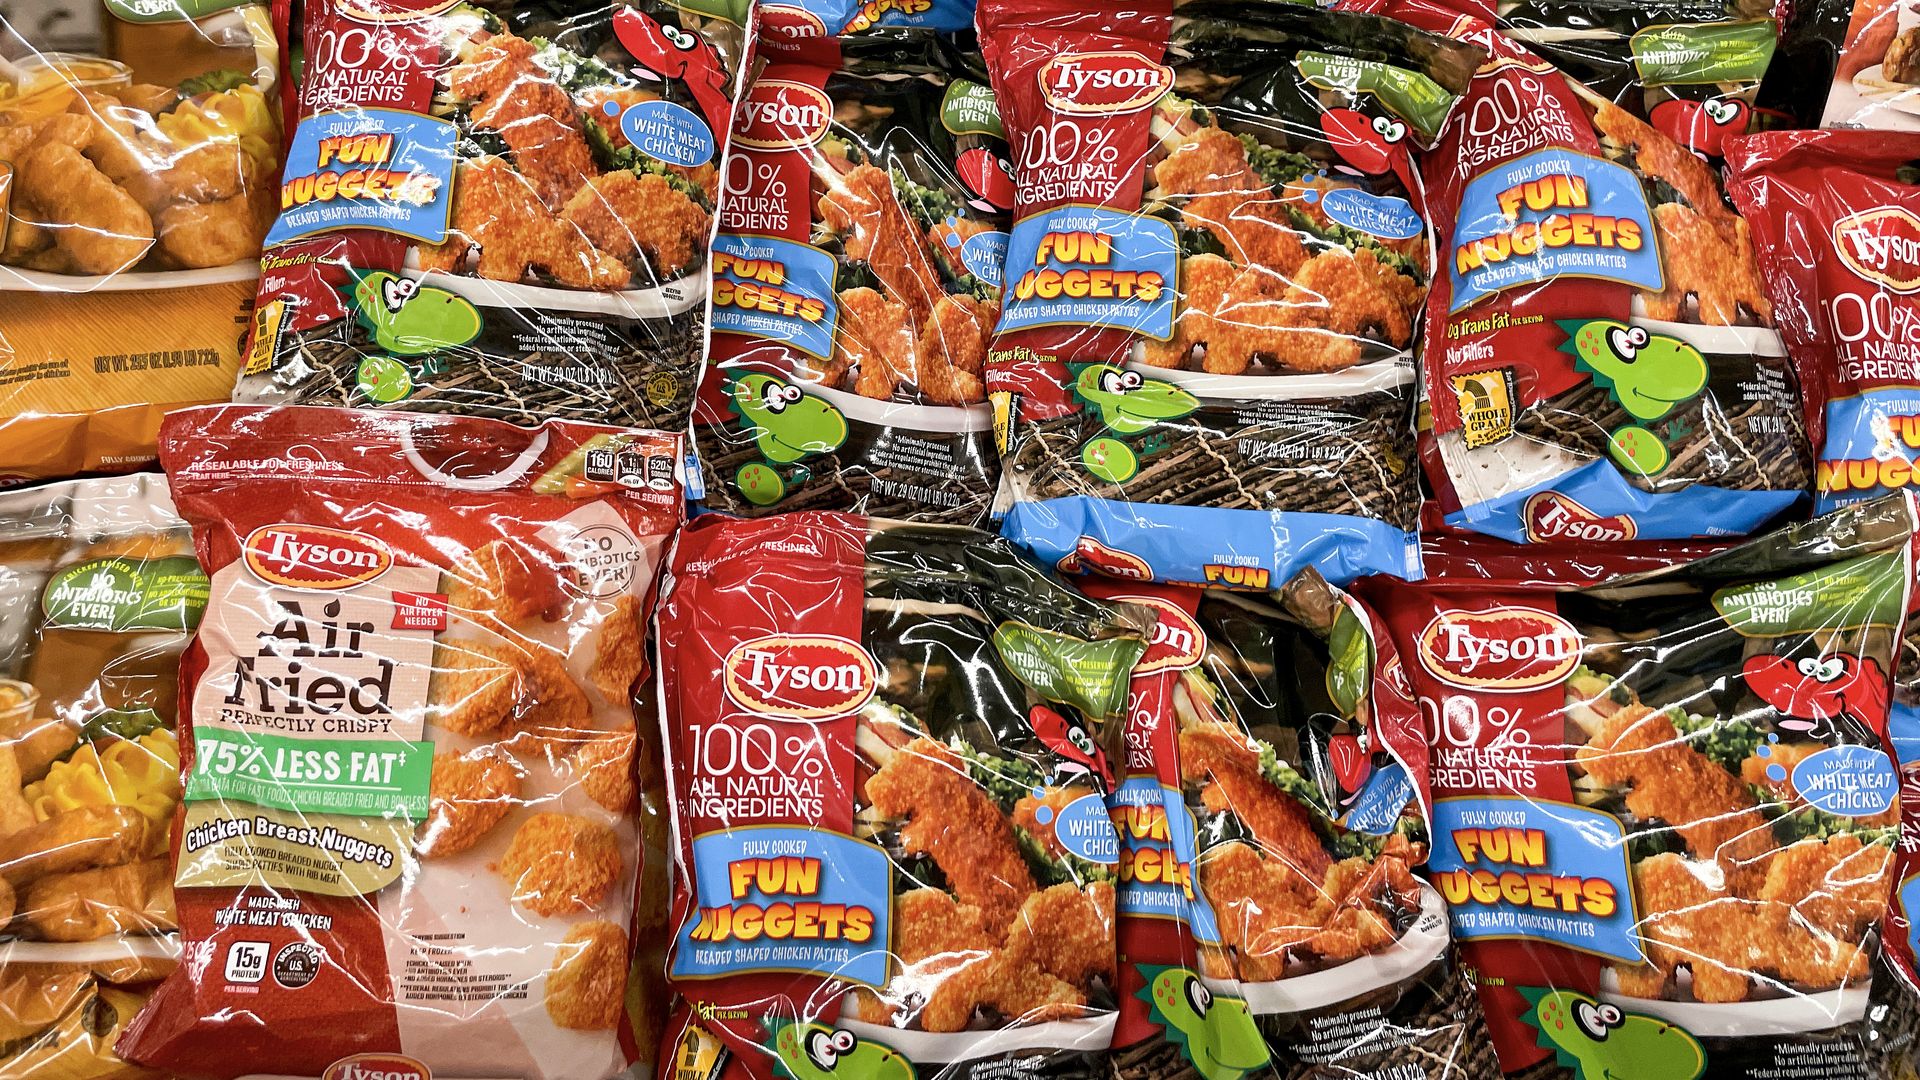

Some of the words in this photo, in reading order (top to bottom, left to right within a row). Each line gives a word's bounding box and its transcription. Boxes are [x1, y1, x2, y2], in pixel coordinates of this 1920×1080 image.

[1053, 61, 1161, 99] Tyson
[968, 85, 986, 97] NO
[651, 110, 675, 124] MADE
[676, 118, 693, 131] WITH
[735, 100, 821, 133] yson
[1454, 77, 1561, 146] 100%
[634, 117, 675, 140] WHITE
[679, 131, 706, 152] MEAT
[1457, 135, 1484, 163] ALL
[1491, 107, 1570, 145] NATURAL
[317, 133, 396, 169] FUN
[644, 137, 696, 164] CHICKEN
[1457, 125, 1575, 179] INGREDIENTS
[1038, 163, 1118, 182] NATURAL
[1507, 165, 1533, 185] FULLY
[1535, 160, 1571, 176] COOKED
[1496, 174, 1589, 223] FUN
[286, 211, 319, 229] BREADED
[322, 207, 349, 222] SHAPED
[349, 206, 378, 220] CHICKEN
[1067, 217, 1098, 230] COOKED
[1333, 201, 1374, 220] WHITE
[1378, 213, 1414, 228] MEAT
[1351, 215, 1404, 236] CHICKEN
[726, 244, 748, 257] FULLY
[750, 247, 774, 259] COOKED
[1036, 230, 1113, 267] FUN
[1455, 213, 1644, 276] NUGGETS
[712, 251, 784, 286] FUN
[1474, 265, 1516, 287] BREADED
[1518, 256, 1554, 277] SHAPED
[1557, 254, 1594, 267] CHICKEN
[1596, 253, 1626, 269] PATTIES
[1011, 269, 1165, 302] UGGETS
[711, 278, 827, 323] GGETS
[712, 311, 740, 324] SHAPED
[742, 315, 776, 330] CHICKEN
[1004, 306, 1038, 321] BREADED
[1041, 305, 1071, 317] SHAPED
[1074, 303, 1108, 316] CHICKEN
[1111, 305, 1139, 317] PATTIES
[1460, 318, 1490, 336] Trans
[1492, 312, 1510, 330] Fat
[988, 348, 1012, 363] Trans
[1014, 346, 1030, 361] Fat
[1446, 347, 1460, 364] No
[1836, 345, 1858, 364] ALL
[985, 369, 1011, 384] Fillers
[1468, 408, 1507, 422] WHOLE
[1887, 400, 1909, 413] FULLY
[1470, 419, 1506, 432] GRAIN
[192, 459, 260, 471] RESEALABLE
[288, 460, 345, 471] FRESHNESS
[590, 453, 613, 468] 160
[588, 467, 614, 477] CALORIES
[625, 489, 641, 500] PER
[871, 479, 884, 494] NET
[898, 484, 908, 498] 29
[908, 486, 918, 501] OZ
[1538, 497, 1625, 542] Tyson
[266, 530, 380, 573] Tyson
[760, 541, 818, 554] FRESHNESS
[101, 560, 131, 573] RAISED
[1214, 554, 1233, 564] FULLY
[1235, 556, 1259, 566] COOKED
[90, 573, 115, 588] NO
[1202, 564, 1270, 589] FUN
[51, 587, 143, 606] ANTIBIOTICS
[415, 597, 428, 608] NO
[1723, 590, 1813, 607] ANTIBIOTICS
[70, 602, 116, 619] EVER!
[400, 607, 415, 617] AIR
[416, 607, 443, 618] FRYER
[1751, 607, 1790, 624] EVER!
[256, 598, 375, 658] Air
[404, 616, 438, 627] NEEDED
[1438, 623, 1568, 673] Tyson
[743, 649, 864, 699] Tyson
[224, 655, 394, 715] Fried
[220, 709, 315, 733] PERFECTLY
[322, 719, 392, 734] CRISPY
[198, 738, 265, 776] 75%
[273, 748, 341, 782] LESS
[689, 723, 824, 777] 100%
[1436, 748, 1534, 768] NATURAL
[690, 778, 721, 796] ALL
[727, 777, 824, 798] NATURAL
[1378, 776, 1394, 792] WITH
[1807, 773, 1858, 791] WHITE
[1859, 773, 1892, 790] MEAT
[232, 781, 247, 794] FOR
[248, 785, 265, 800] FAST
[267, 787, 292, 803] FOODS
[294, 791, 321, 805] CHICKEN
[322, 792, 352, 808] BREADED
[354, 794, 373, 808] FRIED
[375, 795, 389, 809] AND
[391, 795, 427, 812] BONELESS
[1827, 791, 1886, 809] CHICKEN
[690, 798, 823, 818] INGREDIENTS
[1086, 807, 1108, 817] MAD
[1069, 820, 1112, 837] WHITE
[1107, 804, 1172, 841] FUN
[1461, 811, 1486, 826] FULLY
[1489, 811, 1526, 826] COOKED
[186, 818, 251, 853] Chicken
[254, 816, 318, 845] Breast
[319, 826, 394, 870] Nuggets
[743, 840, 769, 856] FULLY
[771, 840, 807, 855] COOKED
[1083, 839, 1119, 856] CHICK
[1452, 827, 1546, 868] FUN
[245, 847, 276, 860] COOKED
[277, 850, 311, 867] BREADED
[312, 858, 344, 872] NUGGET
[252, 860, 283, 874] PATTIES
[285, 864, 305, 877] WITH
[306, 867, 319, 880] RIB
[320, 871, 341, 885] MEAT
[728, 855, 822, 900] FUN
[248, 897, 273, 909] MADE
[1143, 891, 1177, 908] CHICKEN
[215, 909, 245, 925] WHITE
[248, 910, 277, 926] MEAT
[281, 912, 332, 930] CHICKEN
[689, 902, 876, 944] NUGGETS
[1479, 913, 1515, 927] SHAPED
[1517, 915, 1555, 933] CHICKEN
[1556, 919, 1595, 937] PATTIES
[236, 947, 261, 969] 15g
[278, 943, 318, 965] INSPECTED
[695, 949, 733, 965] BREADED
[735, 948, 769, 963] SHAPED
[772, 946, 811, 961] CHICKEN
[813, 947, 849, 963] PATTIES
[231, 970, 260, 979] PROTEIN
[289, 961, 303, 971] U.S.
[697, 1000, 716, 1021] Fat
[1349, 1005, 1381, 1021] processed
[1311, 1030, 1321, 1041] No
[1322, 1025, 1351, 1040] artificial
[1774, 1056, 1785, 1066] No
[1788, 1054, 1824, 1066] artificial
[338, 1063, 420, 1080] Tyson
